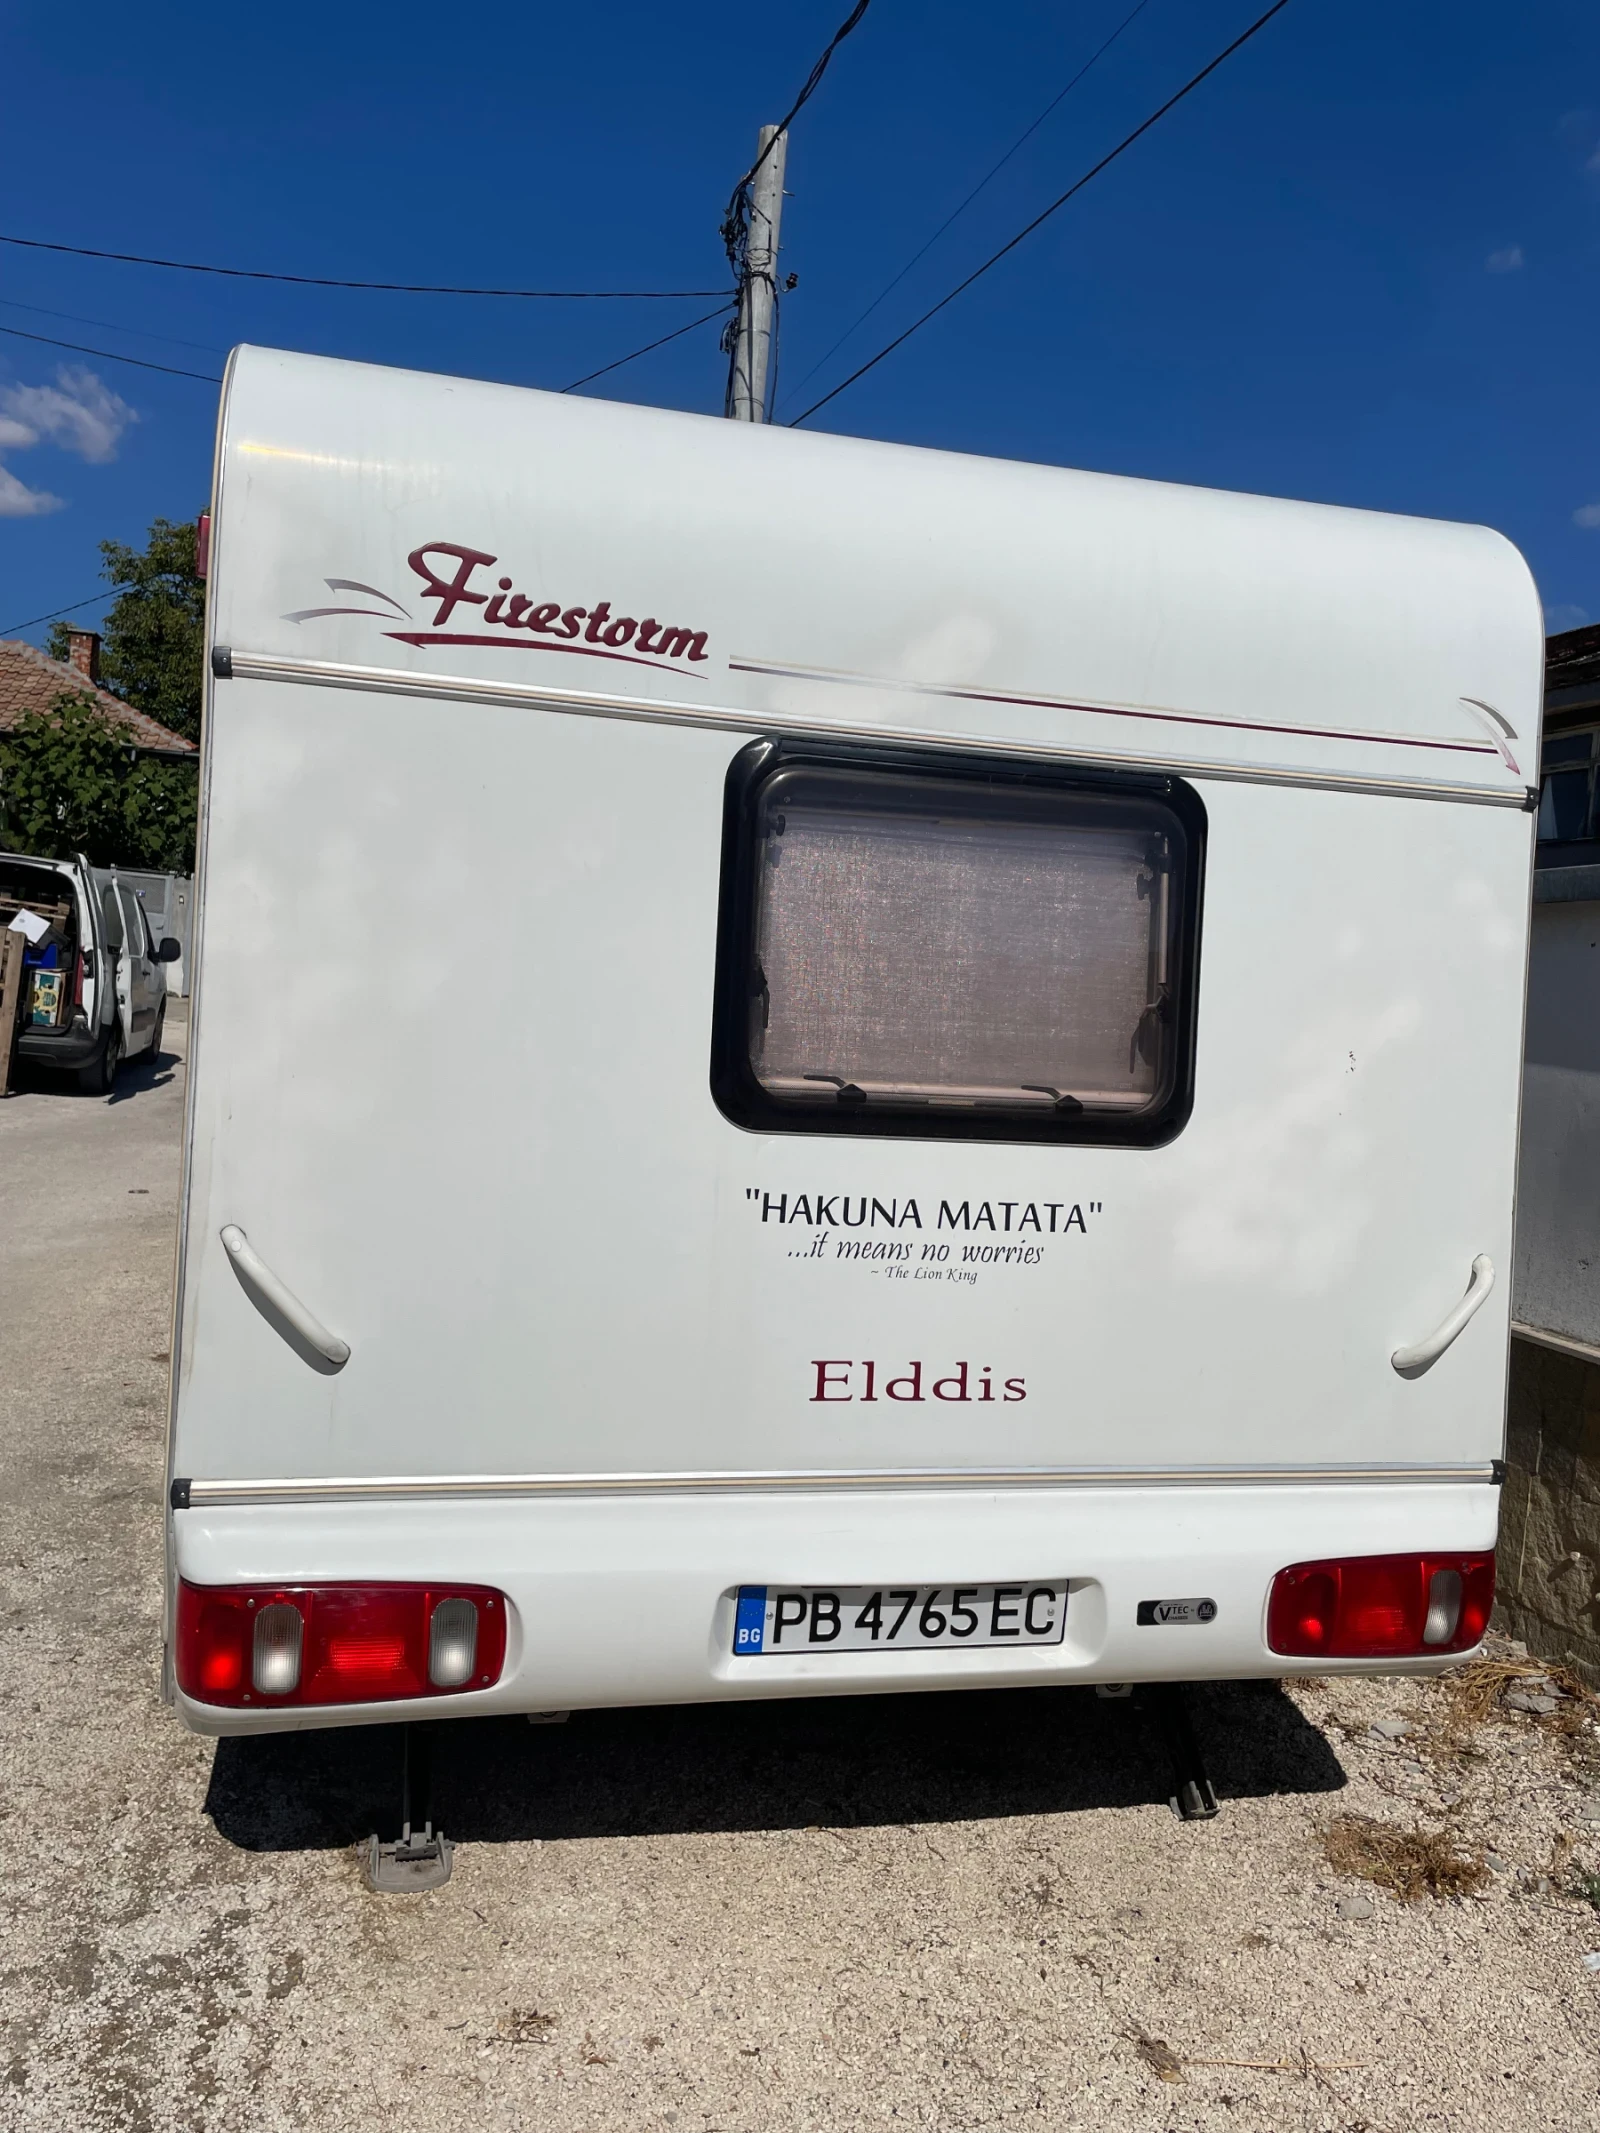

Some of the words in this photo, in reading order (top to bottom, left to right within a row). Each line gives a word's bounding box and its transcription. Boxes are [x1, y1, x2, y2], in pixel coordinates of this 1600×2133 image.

[407, 541, 709, 661] Firestorm
[745, 1188, 922, 1228] "HAKUNA
[937, 1200, 1103, 1233] MATATA"
[836, 1241, 913, 1261] means
[921, 1243, 950, 1262] no
[961, 1240, 1045, 1264] worries
[884, 1265, 909, 1279] The
[914, 1267, 942, 1279] Lion
[946, 1268, 978, 1285] King
[809, 1360, 1027, 1402] Elddis
[738, 1627, 761, 1644] BG
[772, 1592, 841, 1644] PB
[854, 1589, 978, 1640] 4765
[990, 1587, 1056, 1636] EC
